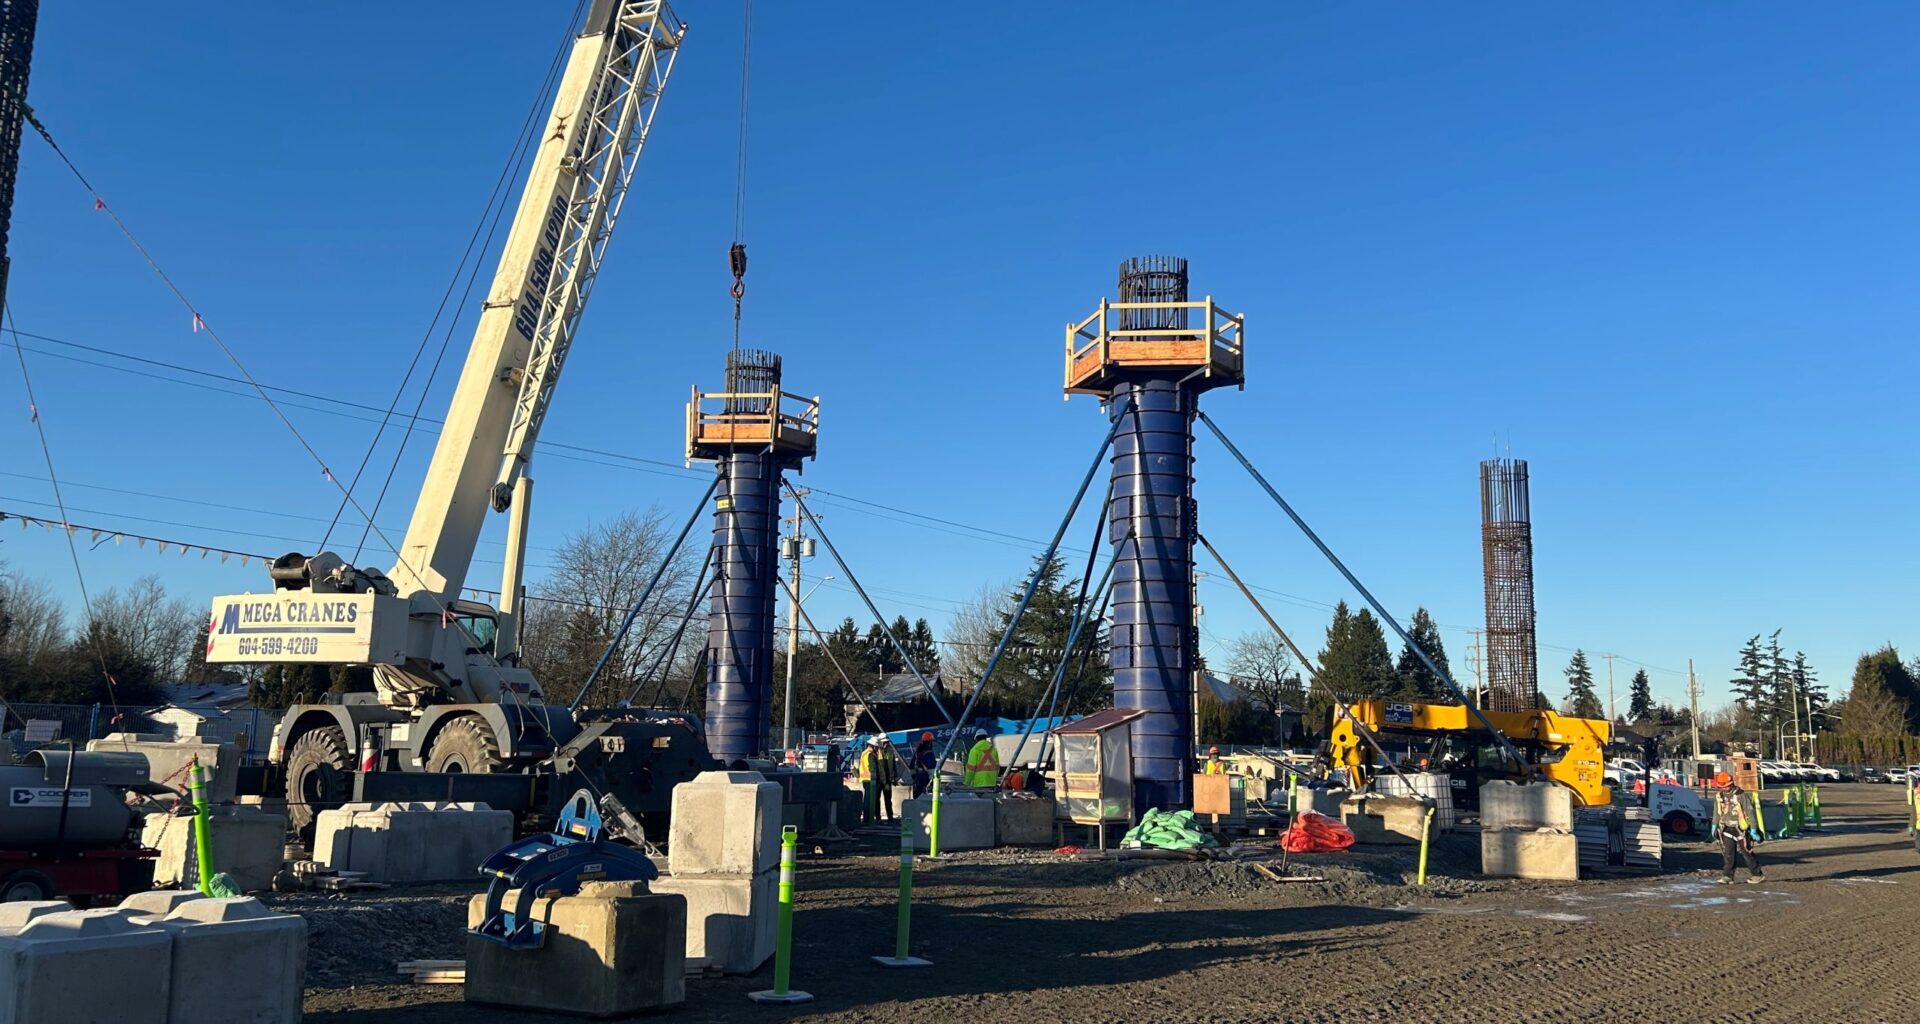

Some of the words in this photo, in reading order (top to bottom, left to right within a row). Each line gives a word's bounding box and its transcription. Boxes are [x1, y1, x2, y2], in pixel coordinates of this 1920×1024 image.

[243, 602, 282, 622] MEGA
[287, 602, 358, 622] CRANES
[239, 636, 318, 655] 604-599-4200
[1386, 703, 1412, 712] JCB
[937, 726, 976, 737] Z-6037F
